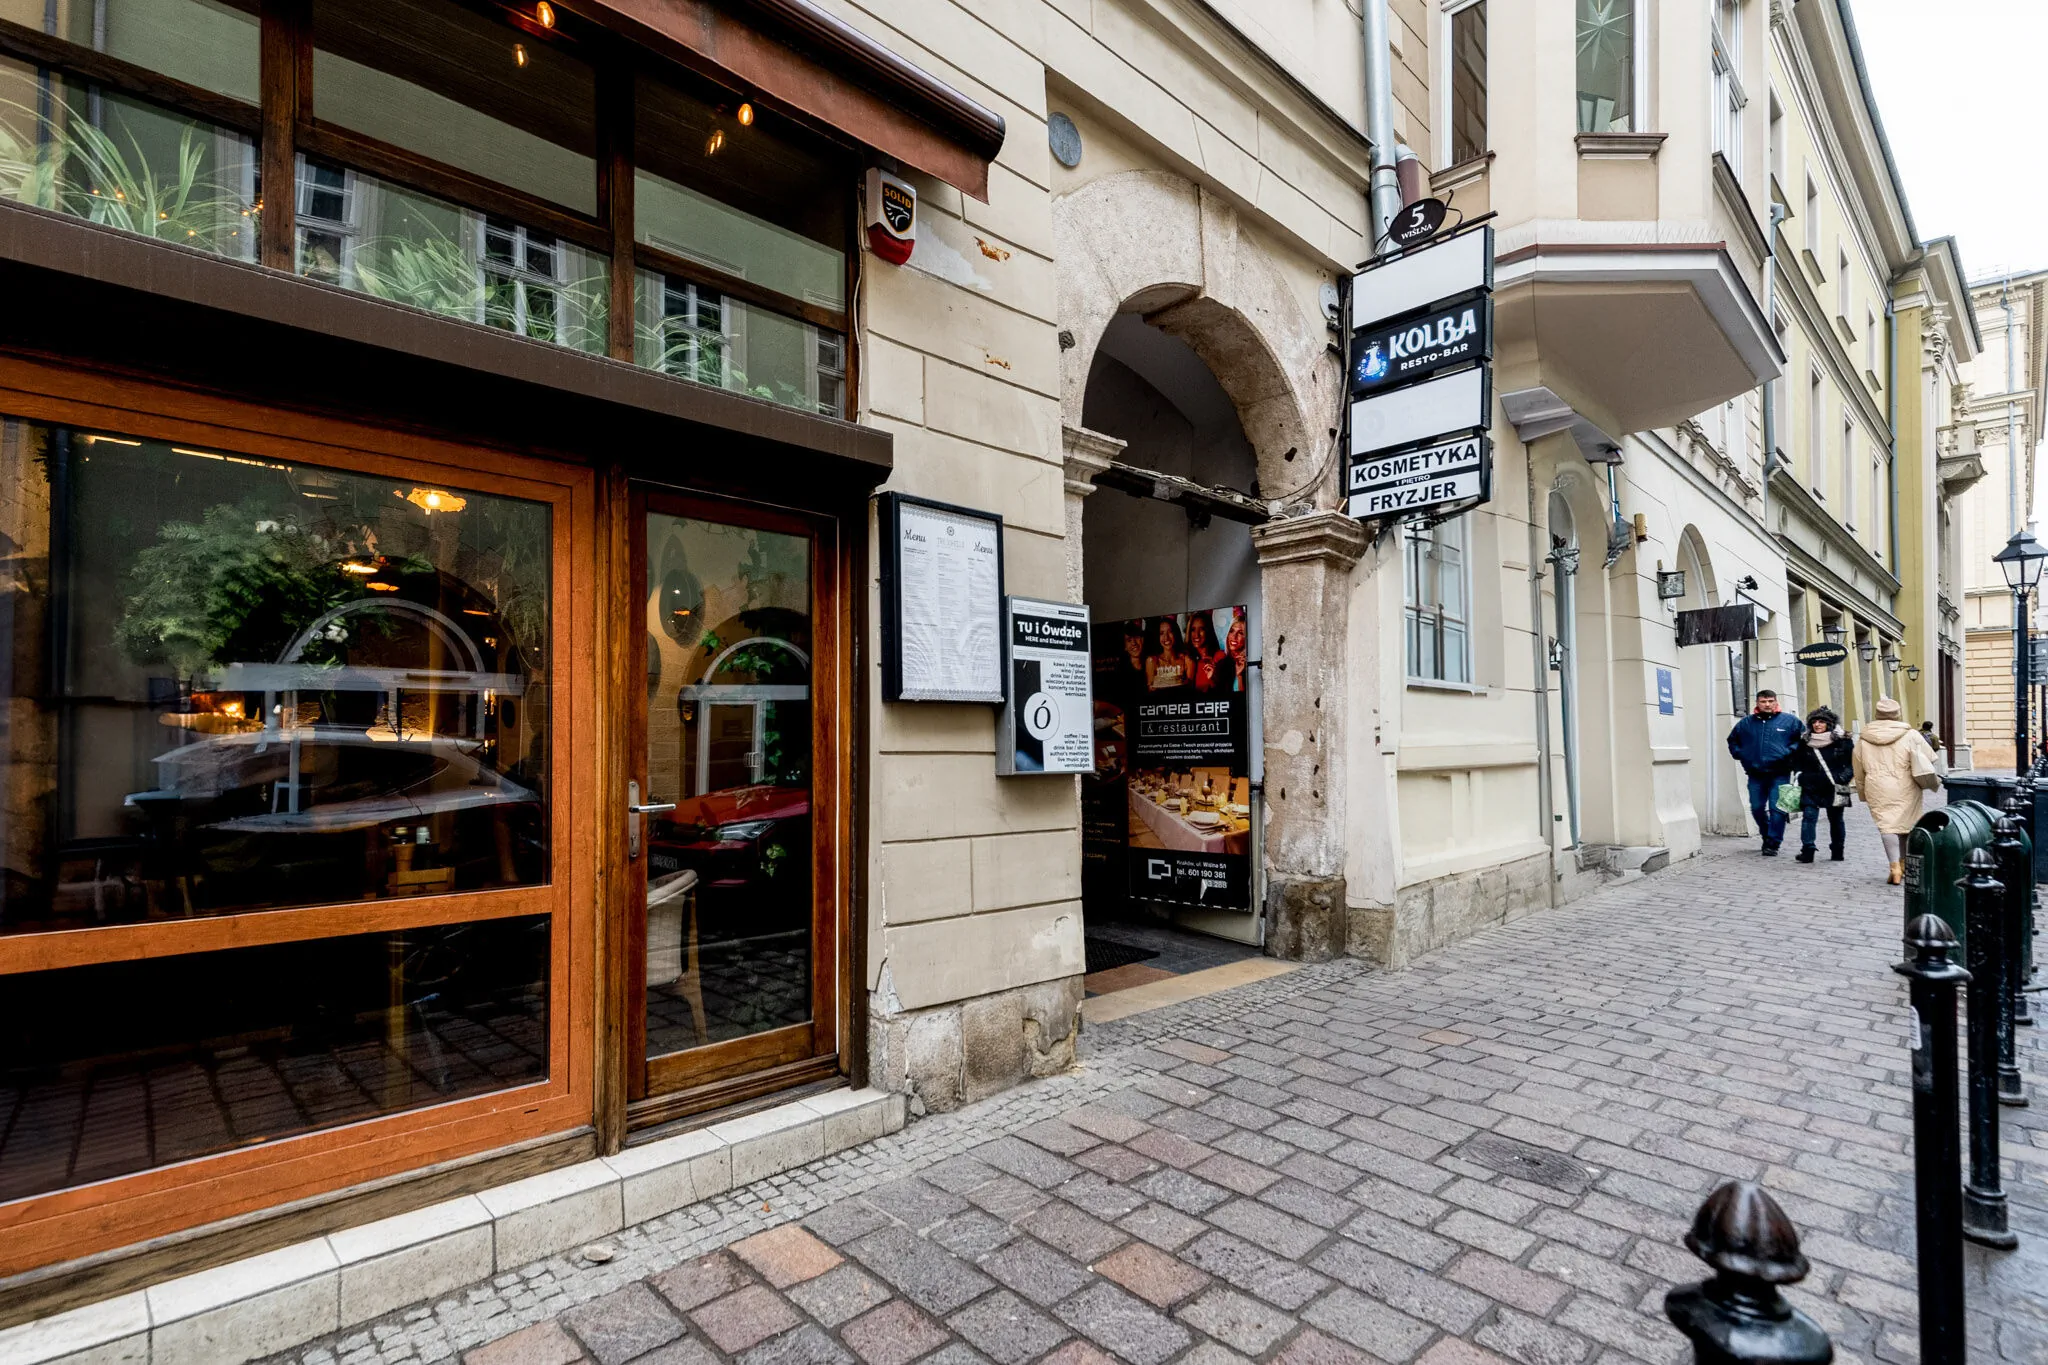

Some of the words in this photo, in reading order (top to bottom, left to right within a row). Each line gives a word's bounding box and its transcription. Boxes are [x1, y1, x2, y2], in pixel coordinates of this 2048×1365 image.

[884, 187, 912, 209] SOLID
[1409, 203, 1425, 228] 5
[1401, 223, 1433, 240] WIŚLNA
[1389, 309, 1476, 360] KOLBA
[1400, 343, 1468, 371] RESTO-BAR
[1355, 443, 1477, 484] KOSMETYKA
[1401, 474, 1431, 486] PIĘTRO
[1370, 481, 1457, 512] FRYZJER
[904, 528, 926, 542] Menu
[973, 541, 993, 554] Menu
[1017, 621, 1032, 634] TU
[1035, 622, 1039, 634] i
[1042, 621, 1082, 638] Ówdzie
[1050, 638, 1073, 646] Elsewhere
[1034, 700, 1051, 730] Ó
[1140, 703, 1190, 716] camera
[1195, 701, 1230, 717] cafe
[1148, 722, 1153, 733] &
[1158, 721, 1220, 733] restaurant
